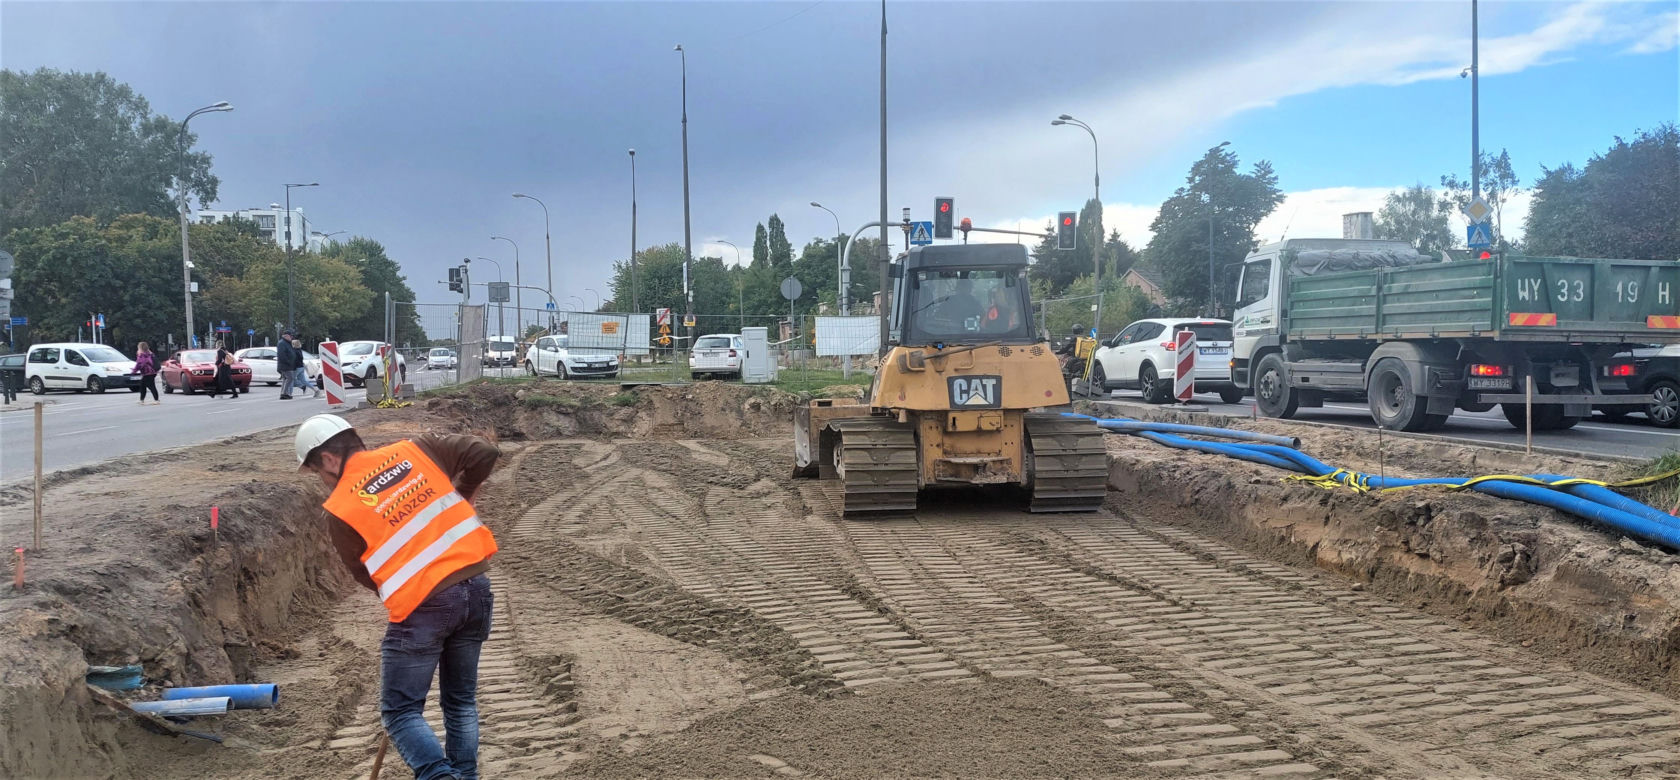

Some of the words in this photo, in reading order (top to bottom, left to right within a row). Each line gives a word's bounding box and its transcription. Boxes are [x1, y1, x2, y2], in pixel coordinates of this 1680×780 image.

[1517, 278, 1542, 301] WY
[1556, 279, 1585, 302] 33
[1615, 281, 1639, 303] 19
[1658, 281, 1670, 304] H
[953, 378, 997, 406] CAT
[388, 487, 436, 527] NADZÓR
